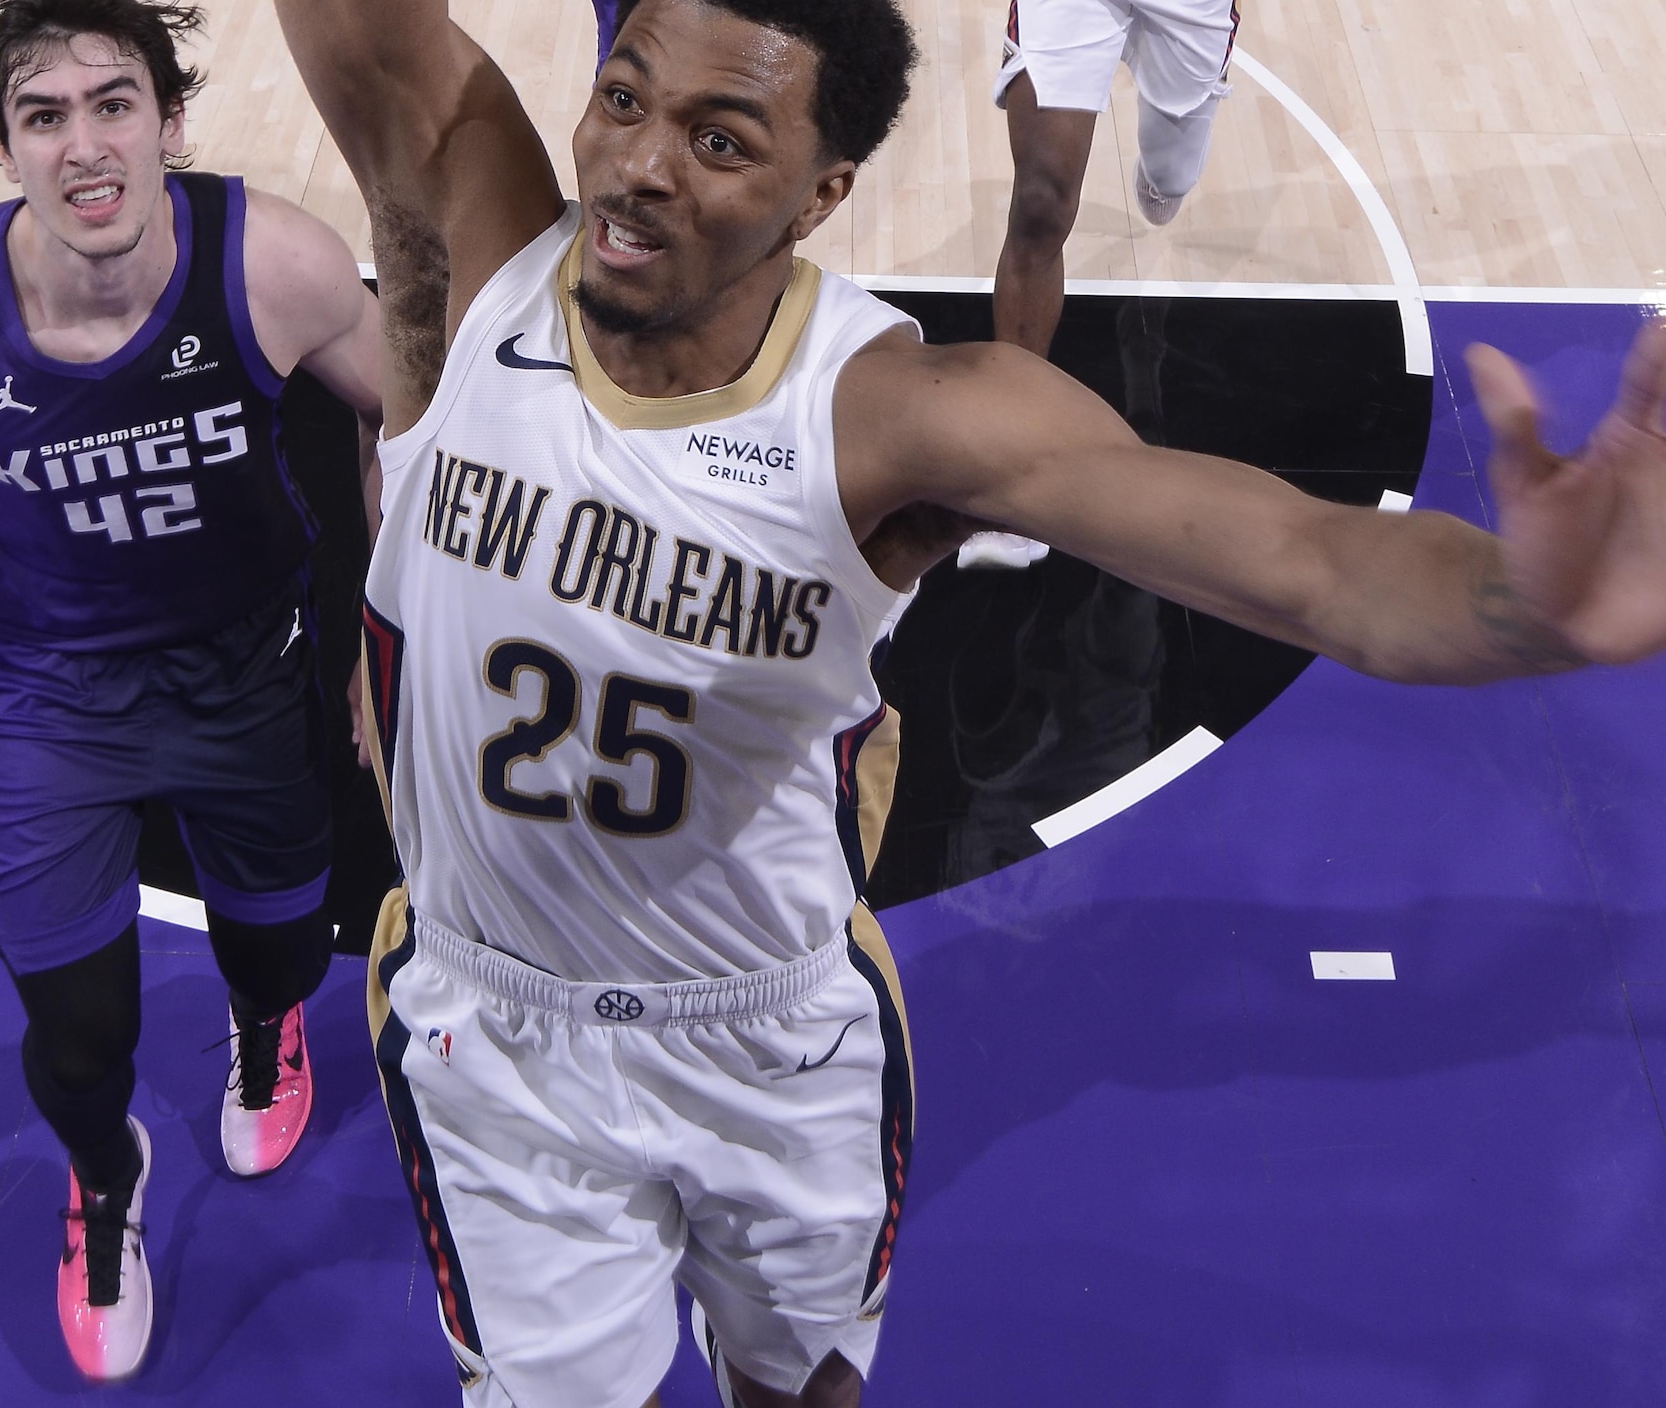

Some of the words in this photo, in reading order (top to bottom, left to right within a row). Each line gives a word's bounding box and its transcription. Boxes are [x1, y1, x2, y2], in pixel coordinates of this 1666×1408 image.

[160, 367, 197, 381] PHOONG
[198, 361, 219, 371] LAW
[39, 417, 186, 457] SACRAMENTO
[686, 431, 797, 472] NEWAGE
[707, 463, 769, 487] GRILLS
[63, 483, 203, 544] 42
[423, 447, 552, 581] NEW
[548, 498, 833, 660] ORLEANS
[477, 637, 697, 839] 25
